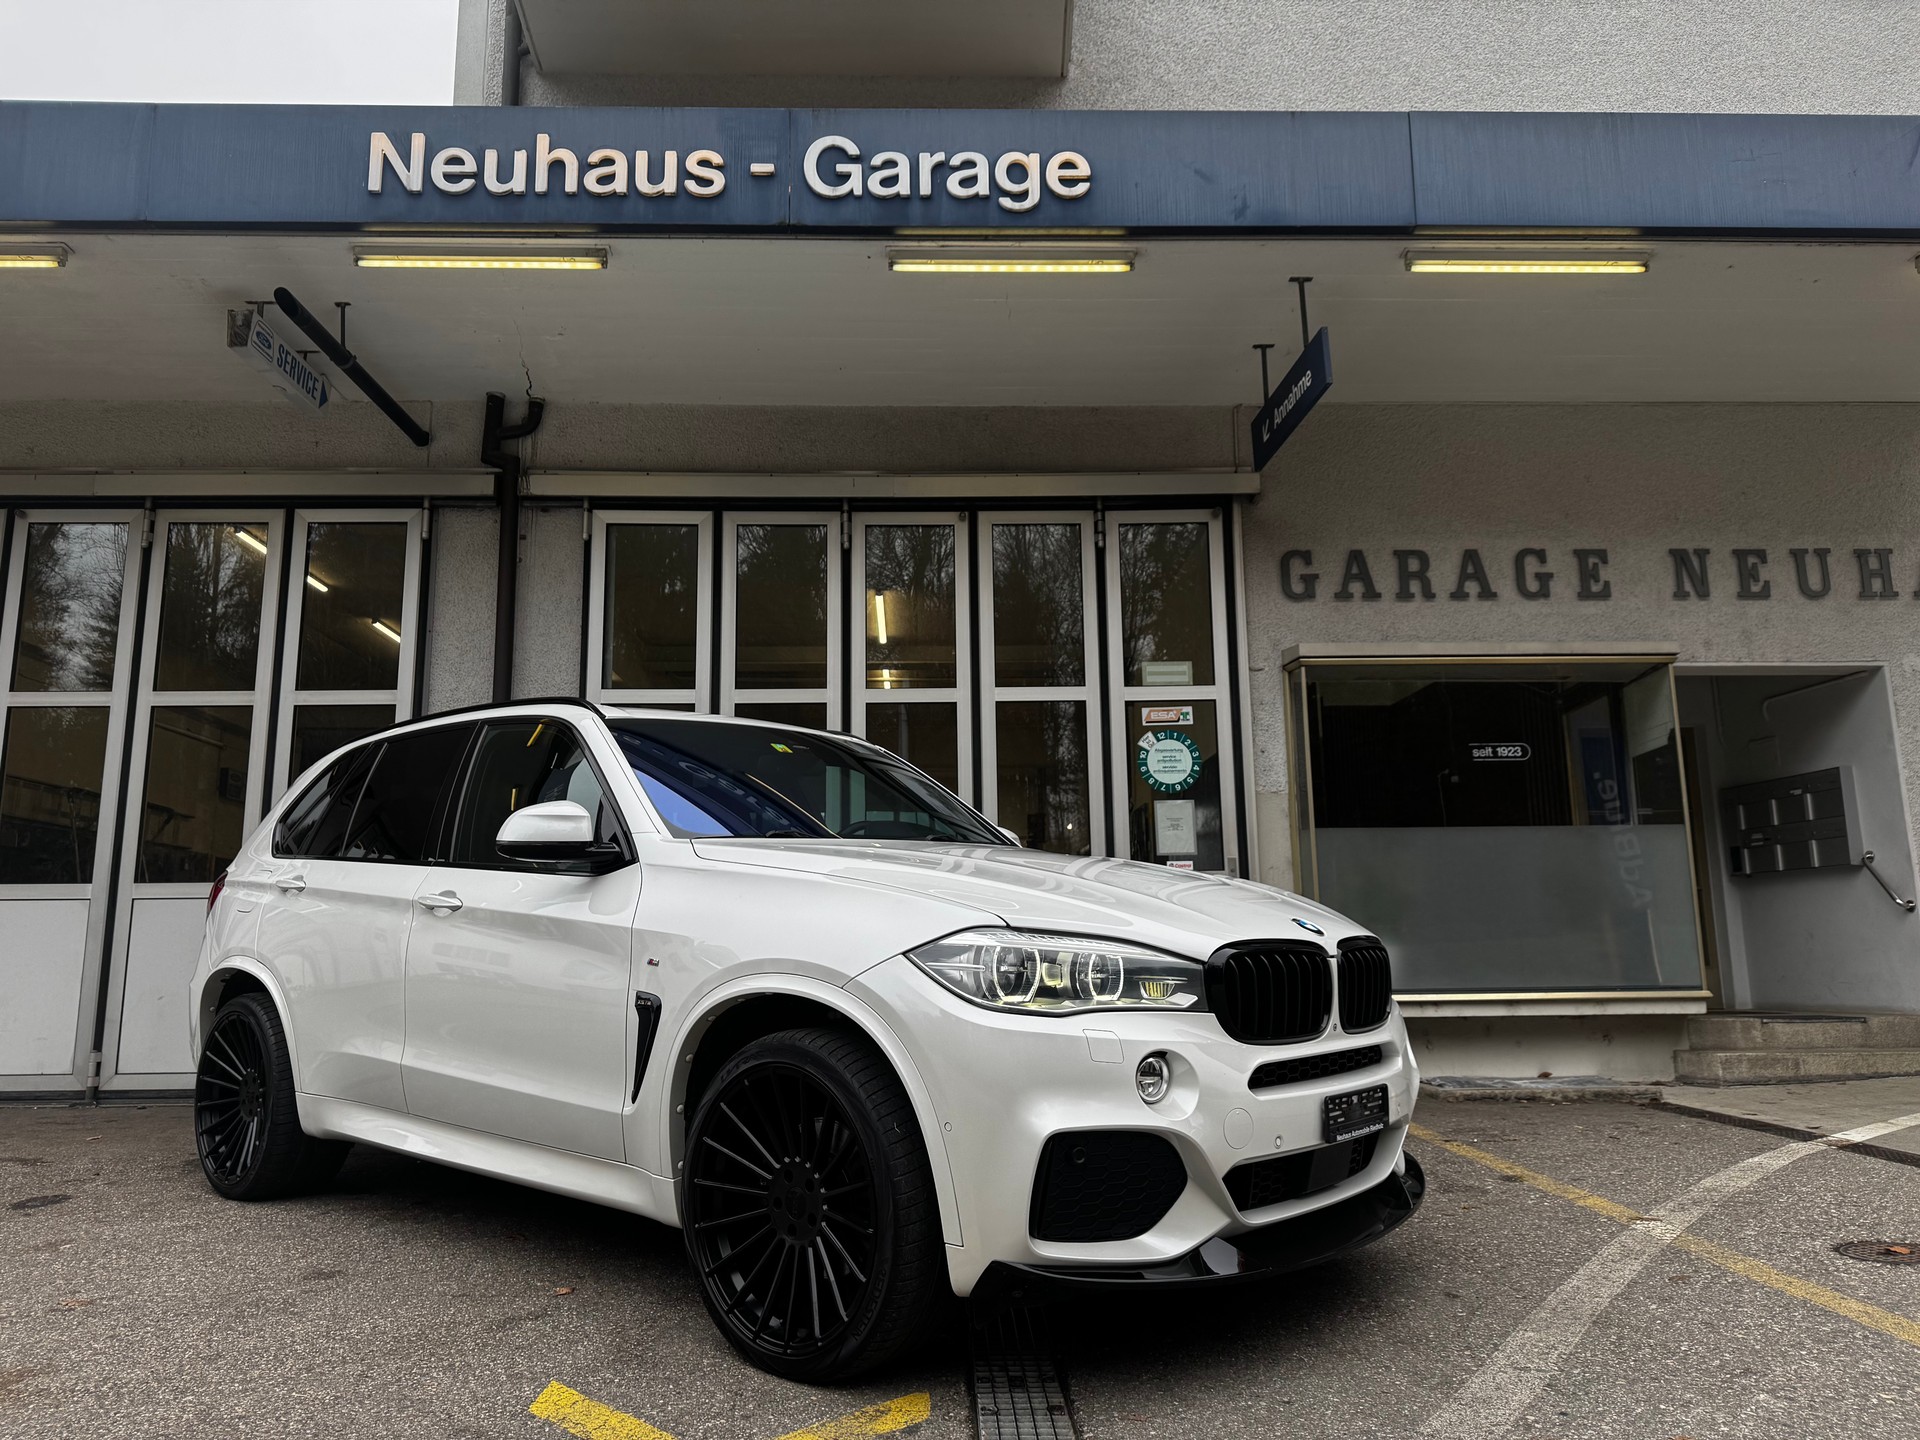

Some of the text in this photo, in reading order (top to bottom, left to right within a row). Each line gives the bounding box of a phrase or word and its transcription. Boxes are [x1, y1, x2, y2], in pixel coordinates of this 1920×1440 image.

[366, 132, 1092, 213] Neuhaus - Garage
[276, 343, 319, 401] SERVICE
[1274, 369, 1312, 429] Annahme
[1279, 548, 1920, 600] GARAGE NEUH
[1140, 751, 1147, 759] 10
[1472, 746, 1522, 757] seit 1923
